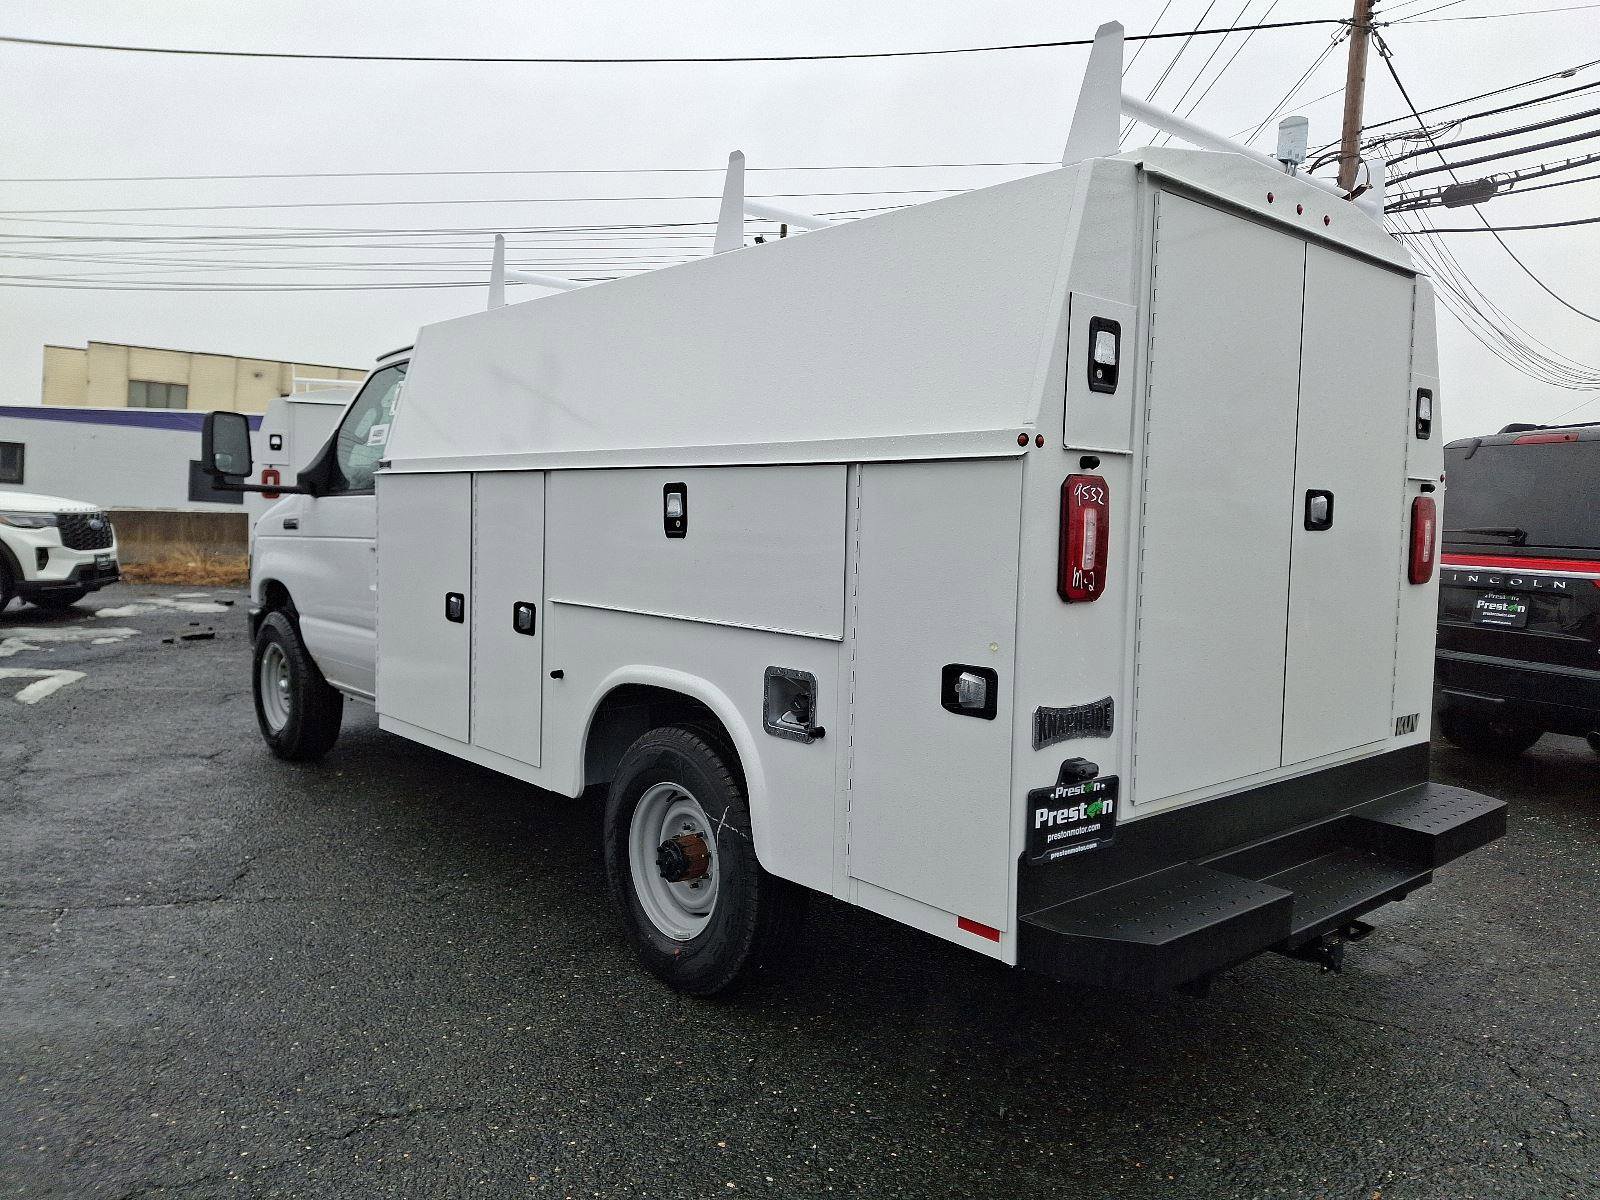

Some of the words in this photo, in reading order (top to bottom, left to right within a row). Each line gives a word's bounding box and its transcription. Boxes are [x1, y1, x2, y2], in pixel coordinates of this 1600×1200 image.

[1073, 482, 1105, 506] 9532
[1440, 573, 1567, 590] INCOLN
[1476, 599, 1526, 613] Preston
[1054, 781, 1101, 799] Preston
[1034, 798, 1114, 829] Preston
[1047, 823, 1101, 844] prestonmotor.com
[1050, 843, 1098, 861] prestonmotor.com
